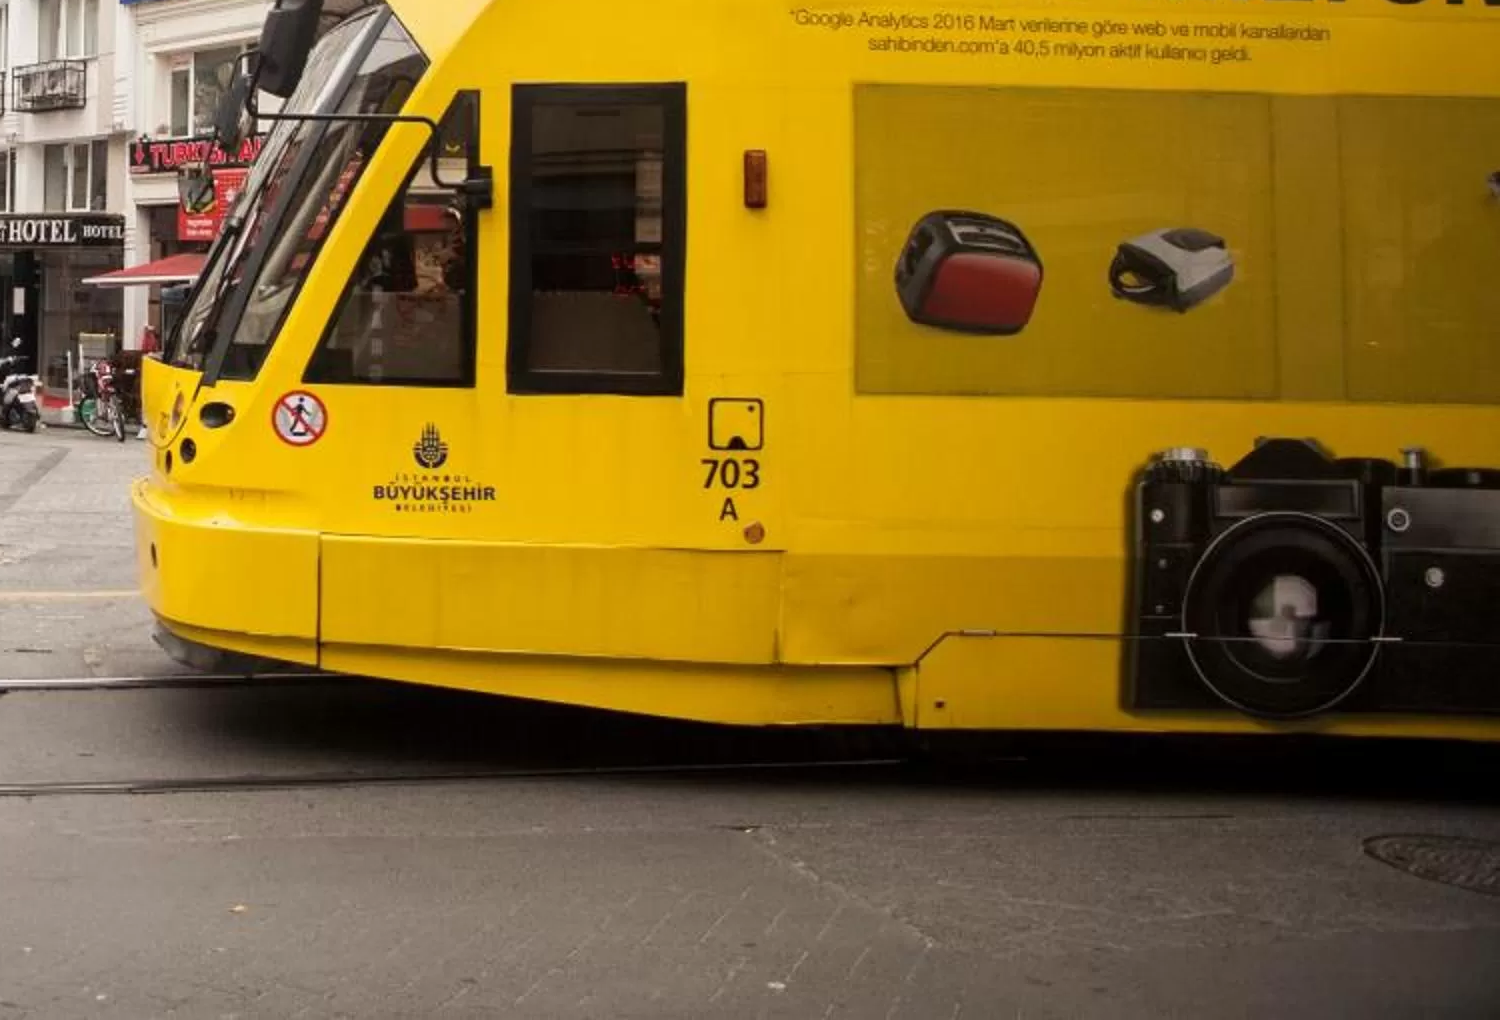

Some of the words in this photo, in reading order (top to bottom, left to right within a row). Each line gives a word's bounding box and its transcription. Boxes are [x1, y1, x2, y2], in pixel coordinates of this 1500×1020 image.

[858, 11, 929, 31] Analytics
[933, 14, 975, 30] 2016
[980, 15, 1015, 30] Mart
[1091, 20, 1128, 39] göre
[1132, 21, 1167, 37] web
[1171, 24, 1189, 37] ve
[1193, 23, 1236, 39] mobil
[1013, 40, 1050, 59] 40,5
[1054, 42, 1105, 61] milyon
[1109, 43, 1141, 59] aktif
[8, 219, 77, 243] HOTEL
[83, 225, 123, 239] HOTEL
[701, 458, 760, 489] 703
[373, 482, 496, 504] BÜYÜKŞEHİR
[719, 497, 738, 521] A
